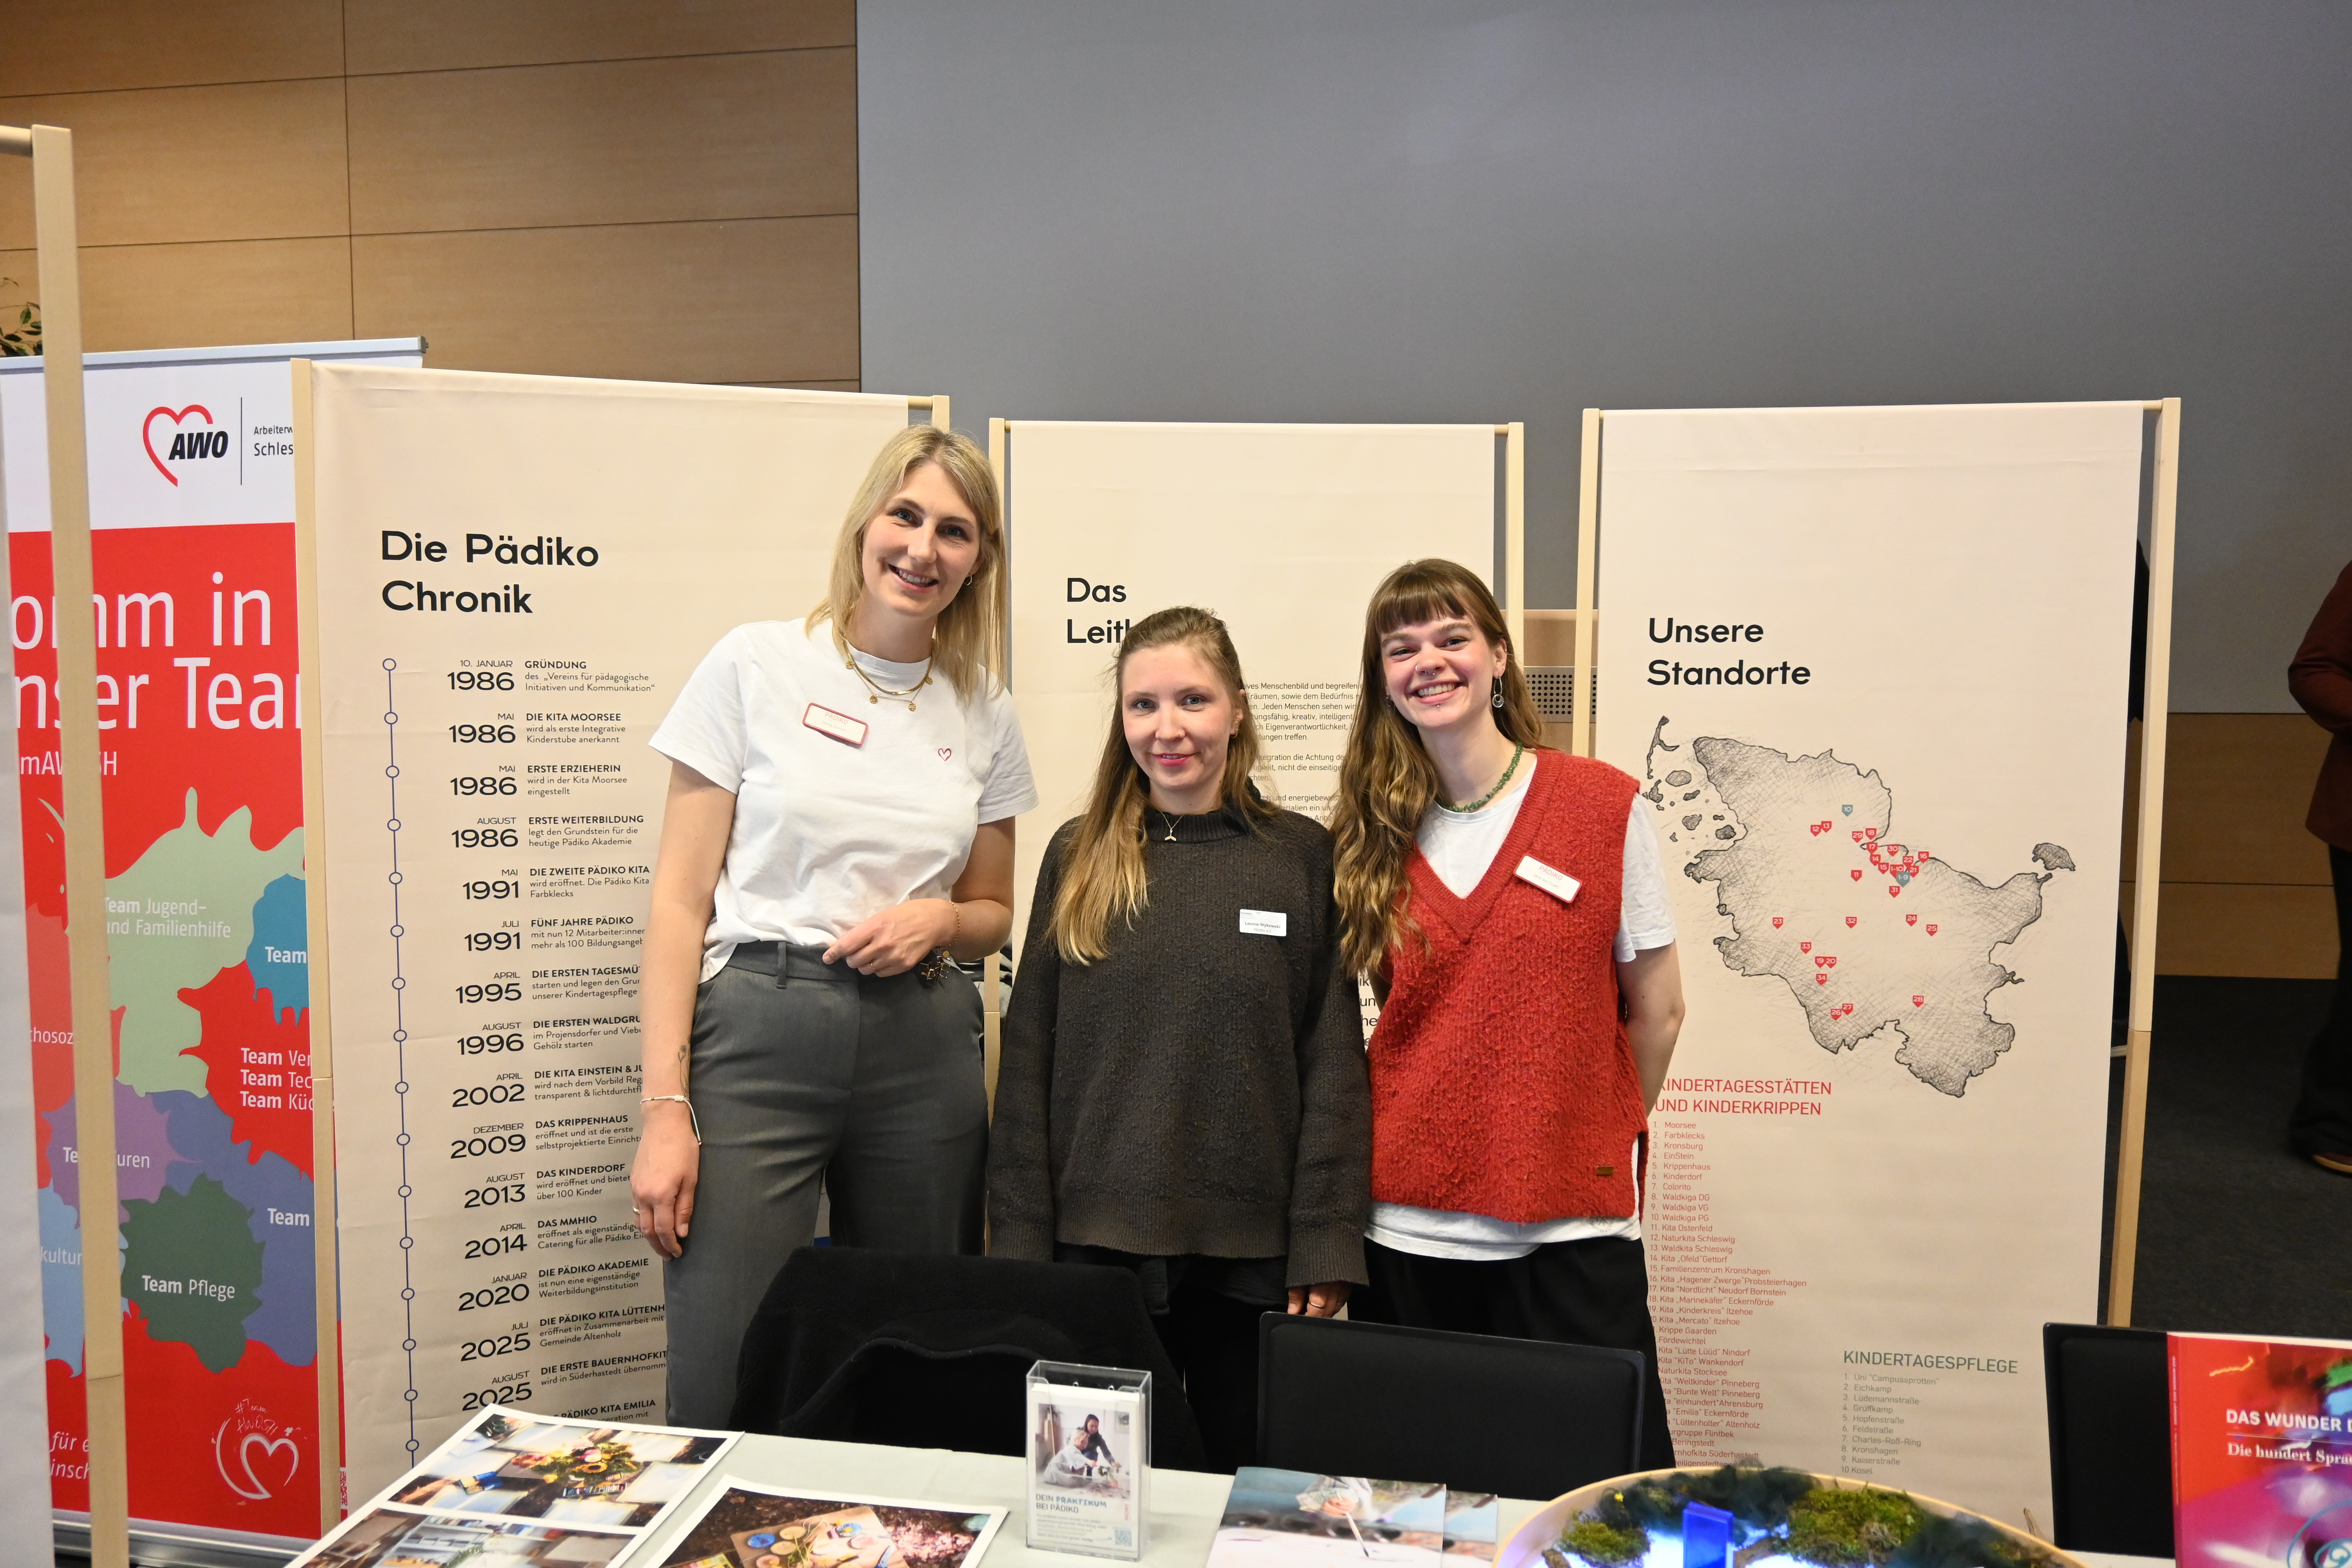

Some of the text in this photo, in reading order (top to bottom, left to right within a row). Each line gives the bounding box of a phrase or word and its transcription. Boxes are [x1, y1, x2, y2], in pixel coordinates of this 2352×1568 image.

[168, 430, 229, 460] AWO
[254, 442, 293, 456] Schles
[382, 531, 598, 566] Die Pädiko
[382, 580, 533, 613] Chronik
[1067, 578, 1126, 602] Das
[213, 572, 270, 645] in
[1650, 618, 1763, 643] Unsere
[525, 659, 586, 669] GRÜNDUNG
[1647, 660, 1810, 685] Standorte
[447, 672, 514, 690] 1986
[1326, 682, 1359, 692] begreifen
[174, 657, 301, 731] Tea
[449, 724, 515, 743] 1986
[450, 777, 517, 795] 1986
[561, 815, 643, 824] WEITERBILDUNG
[452, 829, 518, 848] 1986
[588, 866, 626, 874] PÄDIKO
[1539, 866, 1563, 881] PÄDIKO
[463, 881, 518, 899] 1991
[146, 898, 206, 918] Jugend-
[137, 920, 231, 938] Familienhilfe
[531, 916, 633, 927] FÜNF JAHRE PÄDIKO
[465, 932, 520, 951] 1991
[265, 947, 306, 963] Team
[552, 969, 589, 977] ERSTEN
[456, 983, 522, 1003] 1995
[482, 1022, 521, 1031] AUGUST
[553, 1018, 590, 1027] ERSTEN
[457, 1033, 524, 1055] 1996
[241, 1048, 282, 1064] Team
[241, 1069, 282, 1086] Team
[496, 1073, 523, 1081] APRIL
[578, 1066, 622, 1076] EINSTEIN
[240, 1091, 281, 1108] Team
[452, 1084, 525, 1107] 2002
[1655, 1099, 1821, 1115] UND KINDERKRIPPEN
[474, 1123, 524, 1134] DEZEMBER
[536, 1115, 628, 1128] DAS KRIPPENHAUS
[451, 1134, 525, 1159] 2009
[1664, 1142, 1703, 1151] Kronsburg
[486, 1173, 525, 1183] AUGUST
[537, 1164, 625, 1178] DAS KINDERDORF
[464, 1184, 525, 1208] 2013
[267, 1208, 309, 1226] Team
[538, 1216, 596, 1228] DAS MMHIO
[500, 1223, 526, 1232] APRIL
[465, 1234, 527, 1259] 2014
[1698, 1235, 1735, 1244] Schleswig
[539, 1258, 648, 1277] DIE PÄDIKO AKADEMIE
[492, 1272, 527, 1283] JANUAR
[142, 1275, 235, 1301] Team Pflege
[459, 1284, 529, 1311] 2020
[540, 1304, 664, 1326] DIE PÄDIKO KITA LÜTTENH
[512, 1322, 528, 1331] JULI
[461, 1332, 531, 1361] 2025
[541, 1365, 557, 1375] DIE
[560, 1361, 588, 1372] ERSTE
[1844, 1351, 2017, 1374] KINDERTAGESPFLEGE
[492, 1371, 530, 1384] AUGUST
[462, 1382, 532, 1413] 2025
[1854, 1384, 1892, 1394] Eichkamp
[601, 1405, 621, 1413] KITA
[624, 1400, 656, 1410] EMILIA
[2227, 1410, 2342, 1432] DAS WUNDER
[2228, 1443, 2251, 1456] Die
[2256, 1444, 2313, 1462] hundert
[1051, 1504, 1078, 1513] PÄDIKO
[1056, 1496, 1106, 1508] PRAKTIKUM
